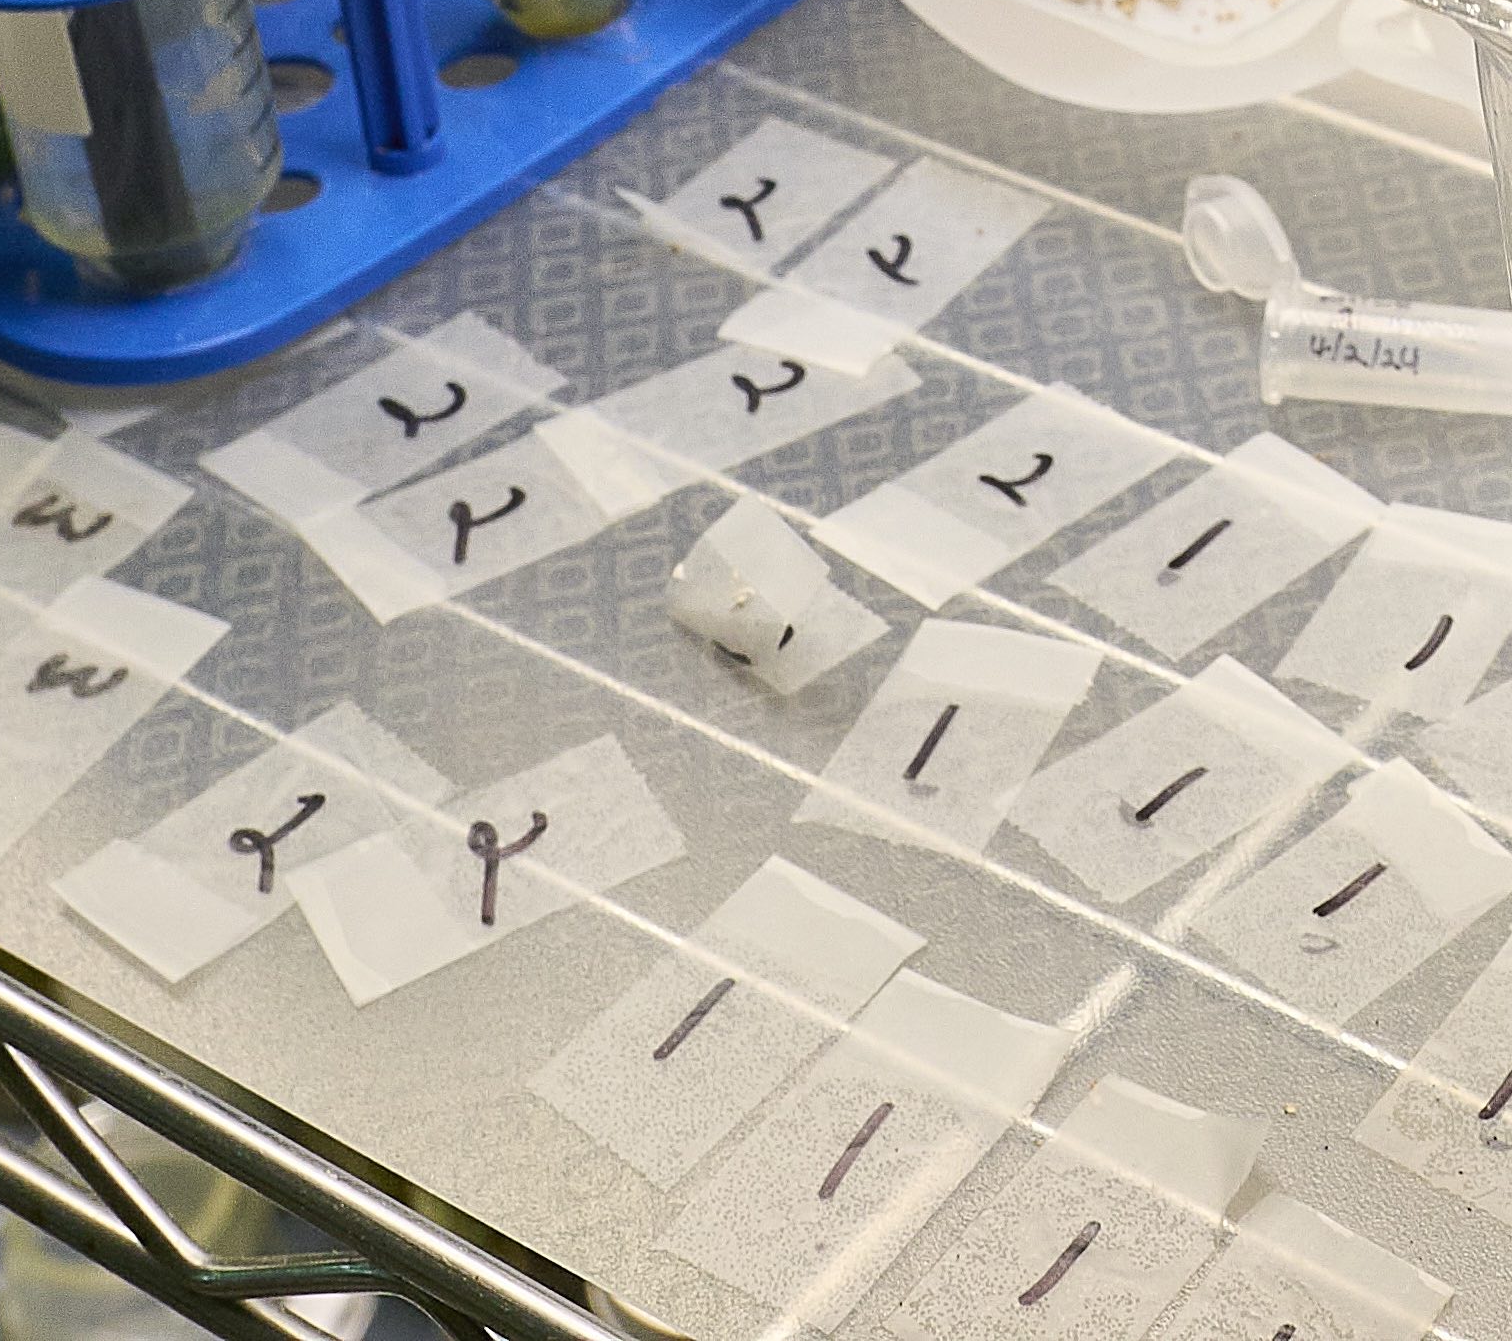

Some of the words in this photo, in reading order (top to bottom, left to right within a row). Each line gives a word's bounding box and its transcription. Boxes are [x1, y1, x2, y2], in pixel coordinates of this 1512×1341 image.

[1310, 331, 1419, 376] 4/2/24
[1167, 519, 1231, 571] 1
[1404, 615, 1454, 671] 1
[904, 704, 959, 781] 1
[1133, 767, 1206, 824] 1
[1312, 863, 1386, 918] 1
[652, 978, 736, 1062] 1
[817, 1102, 895, 1201] 1
[1018, 1220, 1101, 1307] 1
